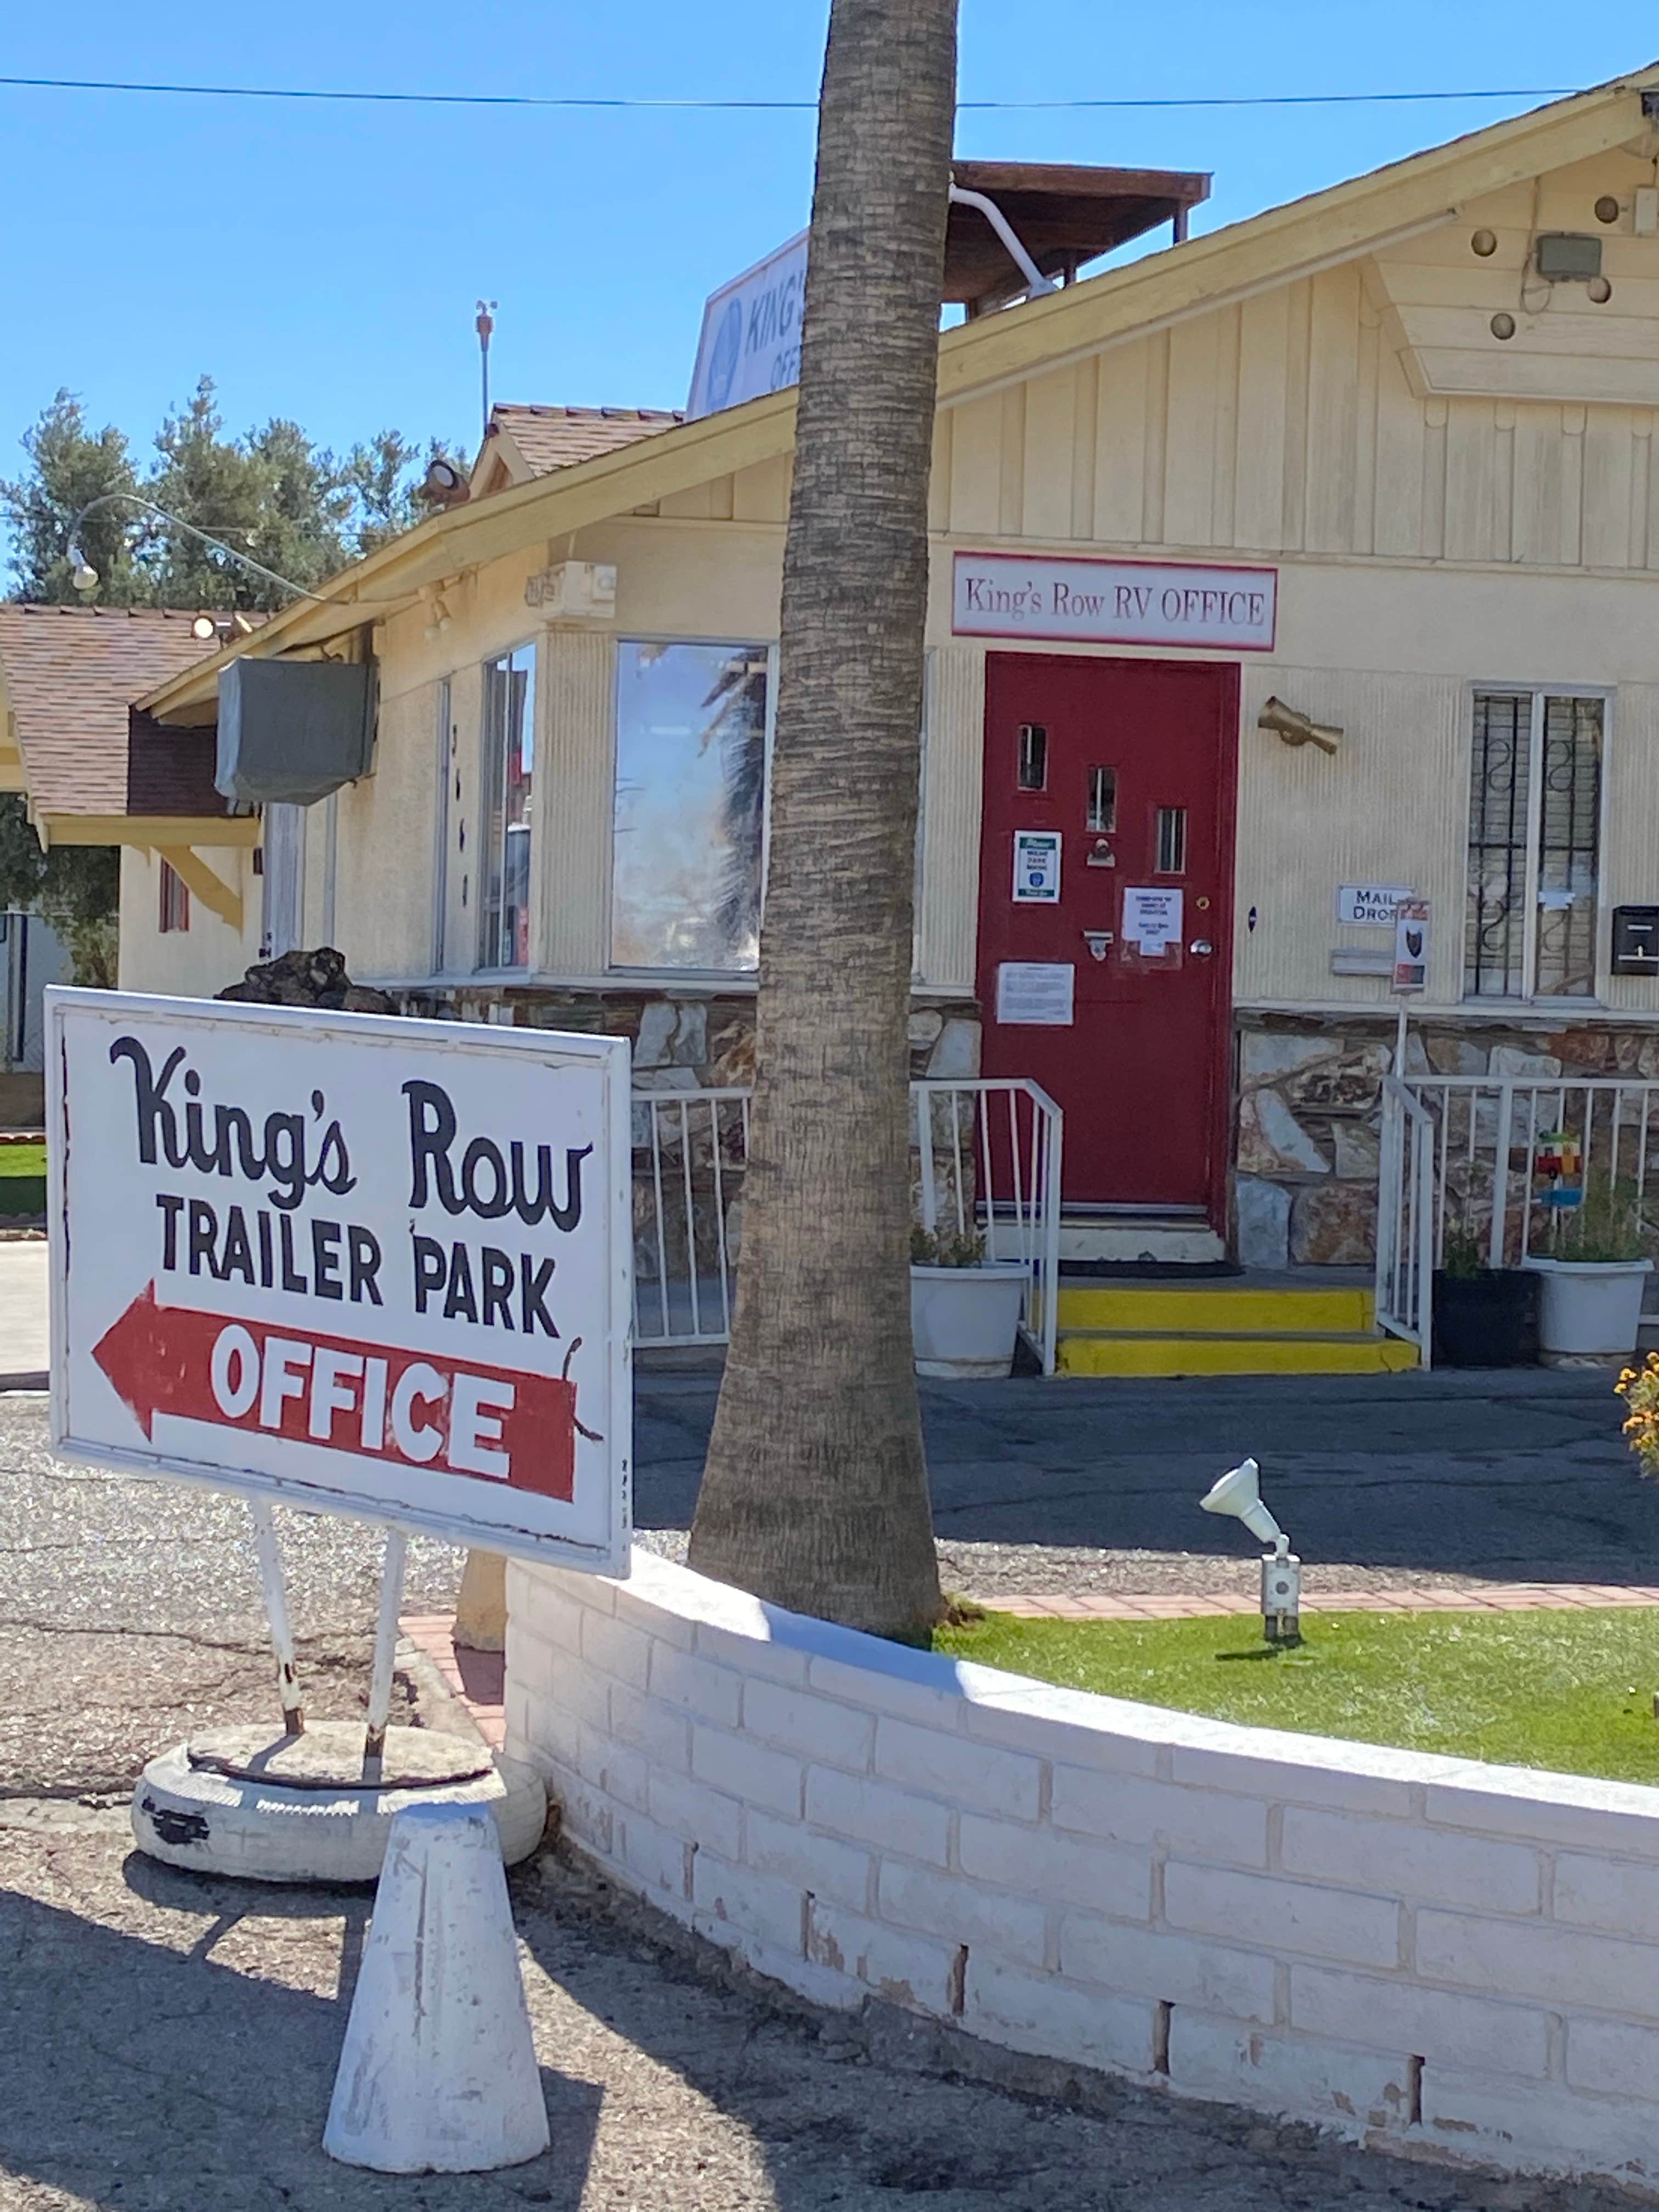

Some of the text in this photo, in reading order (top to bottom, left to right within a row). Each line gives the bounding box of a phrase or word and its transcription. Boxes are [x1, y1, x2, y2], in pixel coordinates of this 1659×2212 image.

[744, 270, 804, 356] KING'
[966, 578, 1263, 625] King's Row RV OFFICE
[1356, 890, 1397, 905] MAIL
[110, 1036, 594, 1232] King's Row
[156, 1194, 560, 1339] TRAILER PARK
[211, 1324, 515, 1479] OFFICE
